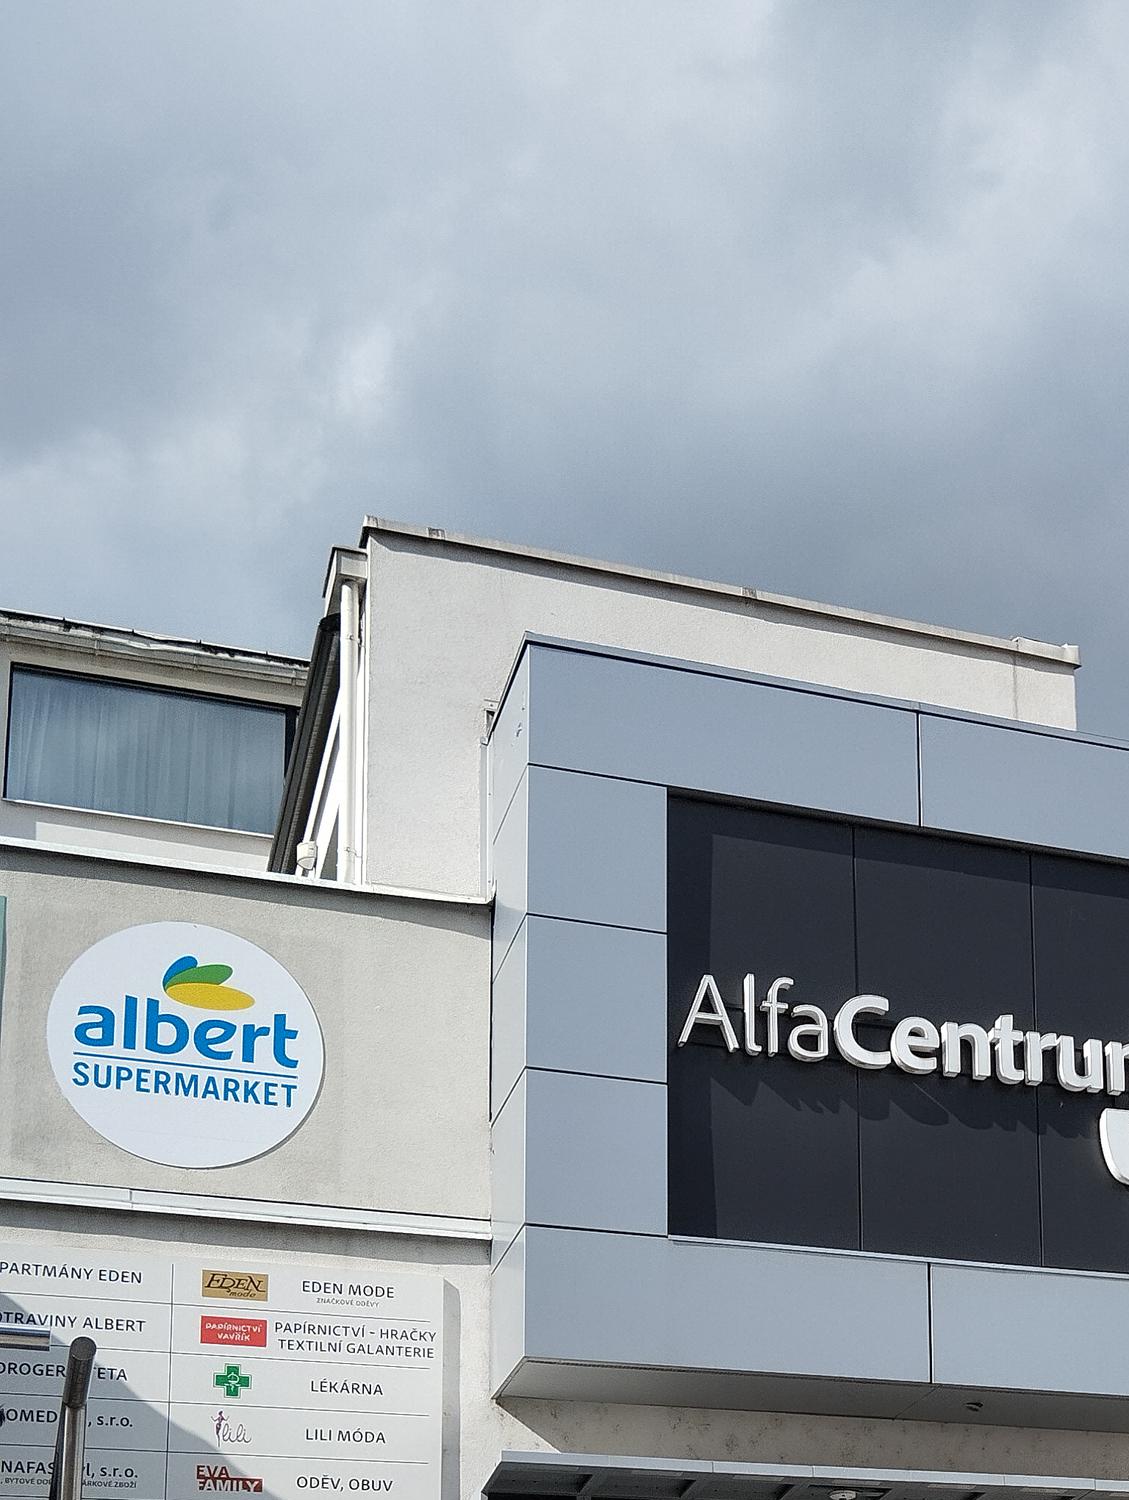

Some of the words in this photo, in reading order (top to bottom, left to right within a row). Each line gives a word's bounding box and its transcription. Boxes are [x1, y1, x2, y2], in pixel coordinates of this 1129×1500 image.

[73, 994, 299, 1069] albert
[72, 1061, 298, 1108] SUPERMARKET
[0, 1262, 93, 1280] PARTMÁNY
[99, 1269, 142, 1284] EDEN
[302, 1280, 343, 1296] EDEN
[348, 1284, 395, 1299] MODE
[0, 1311, 77, 1328] TRAVINY
[83, 1317, 147, 1333] ALBERT
[274, 1321, 366, 1338] PAPÍRNICTVÍ
[379, 1326, 437, 1343] HRAČKY
[278, 1338, 343, 1353] TEXTILNÍ
[346, 1342, 435, 1359] GALANTERIE
[0, 1362, 66, 1378] DROGER
[94, 1367, 128, 1381] ETA
[311, 1377, 383, 1396] LÉKÁRNA
[96, 1415, 133, 1428] s.r.o.
[305, 1428, 332, 1441] LILI
[337, 1427, 386, 1444] MÓDA
[100, 1466, 138, 1479] s.r.o.
[197, 1465, 229, 1479] EVA
[83, 1479, 112, 1488] ÁRKOVÉ
[197, 1478, 259, 1492] FAMILY
[296, 1475, 344, 1492] ODĚV,
[349, 1478, 393, 1492] OBUV
